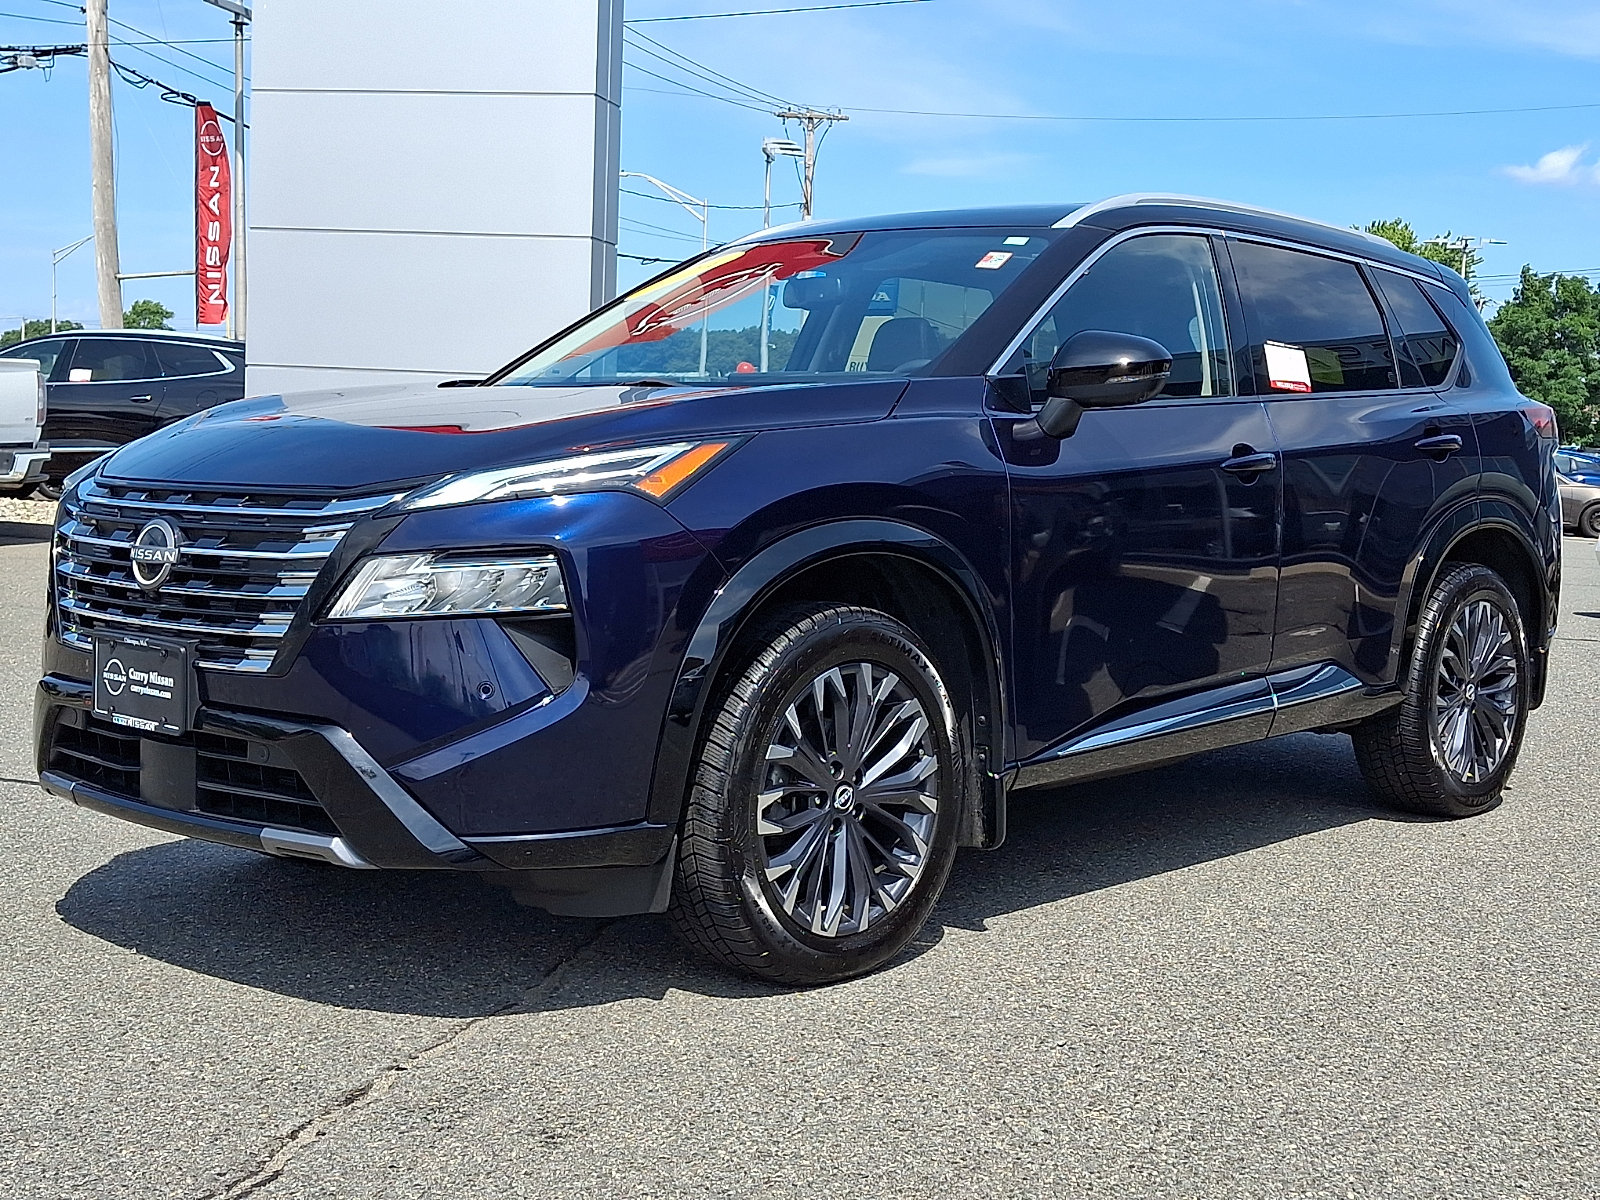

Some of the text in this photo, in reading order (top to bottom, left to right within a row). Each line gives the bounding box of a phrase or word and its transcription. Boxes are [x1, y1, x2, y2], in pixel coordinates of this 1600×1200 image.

[206, 165, 225, 305] NISSAN
[130, 547, 176, 562] NISSAN
[103, 671, 127, 683] NISSAN
[128, 668, 174, 687] Curry Nissan
[127, 718, 156, 731] NISSAN
